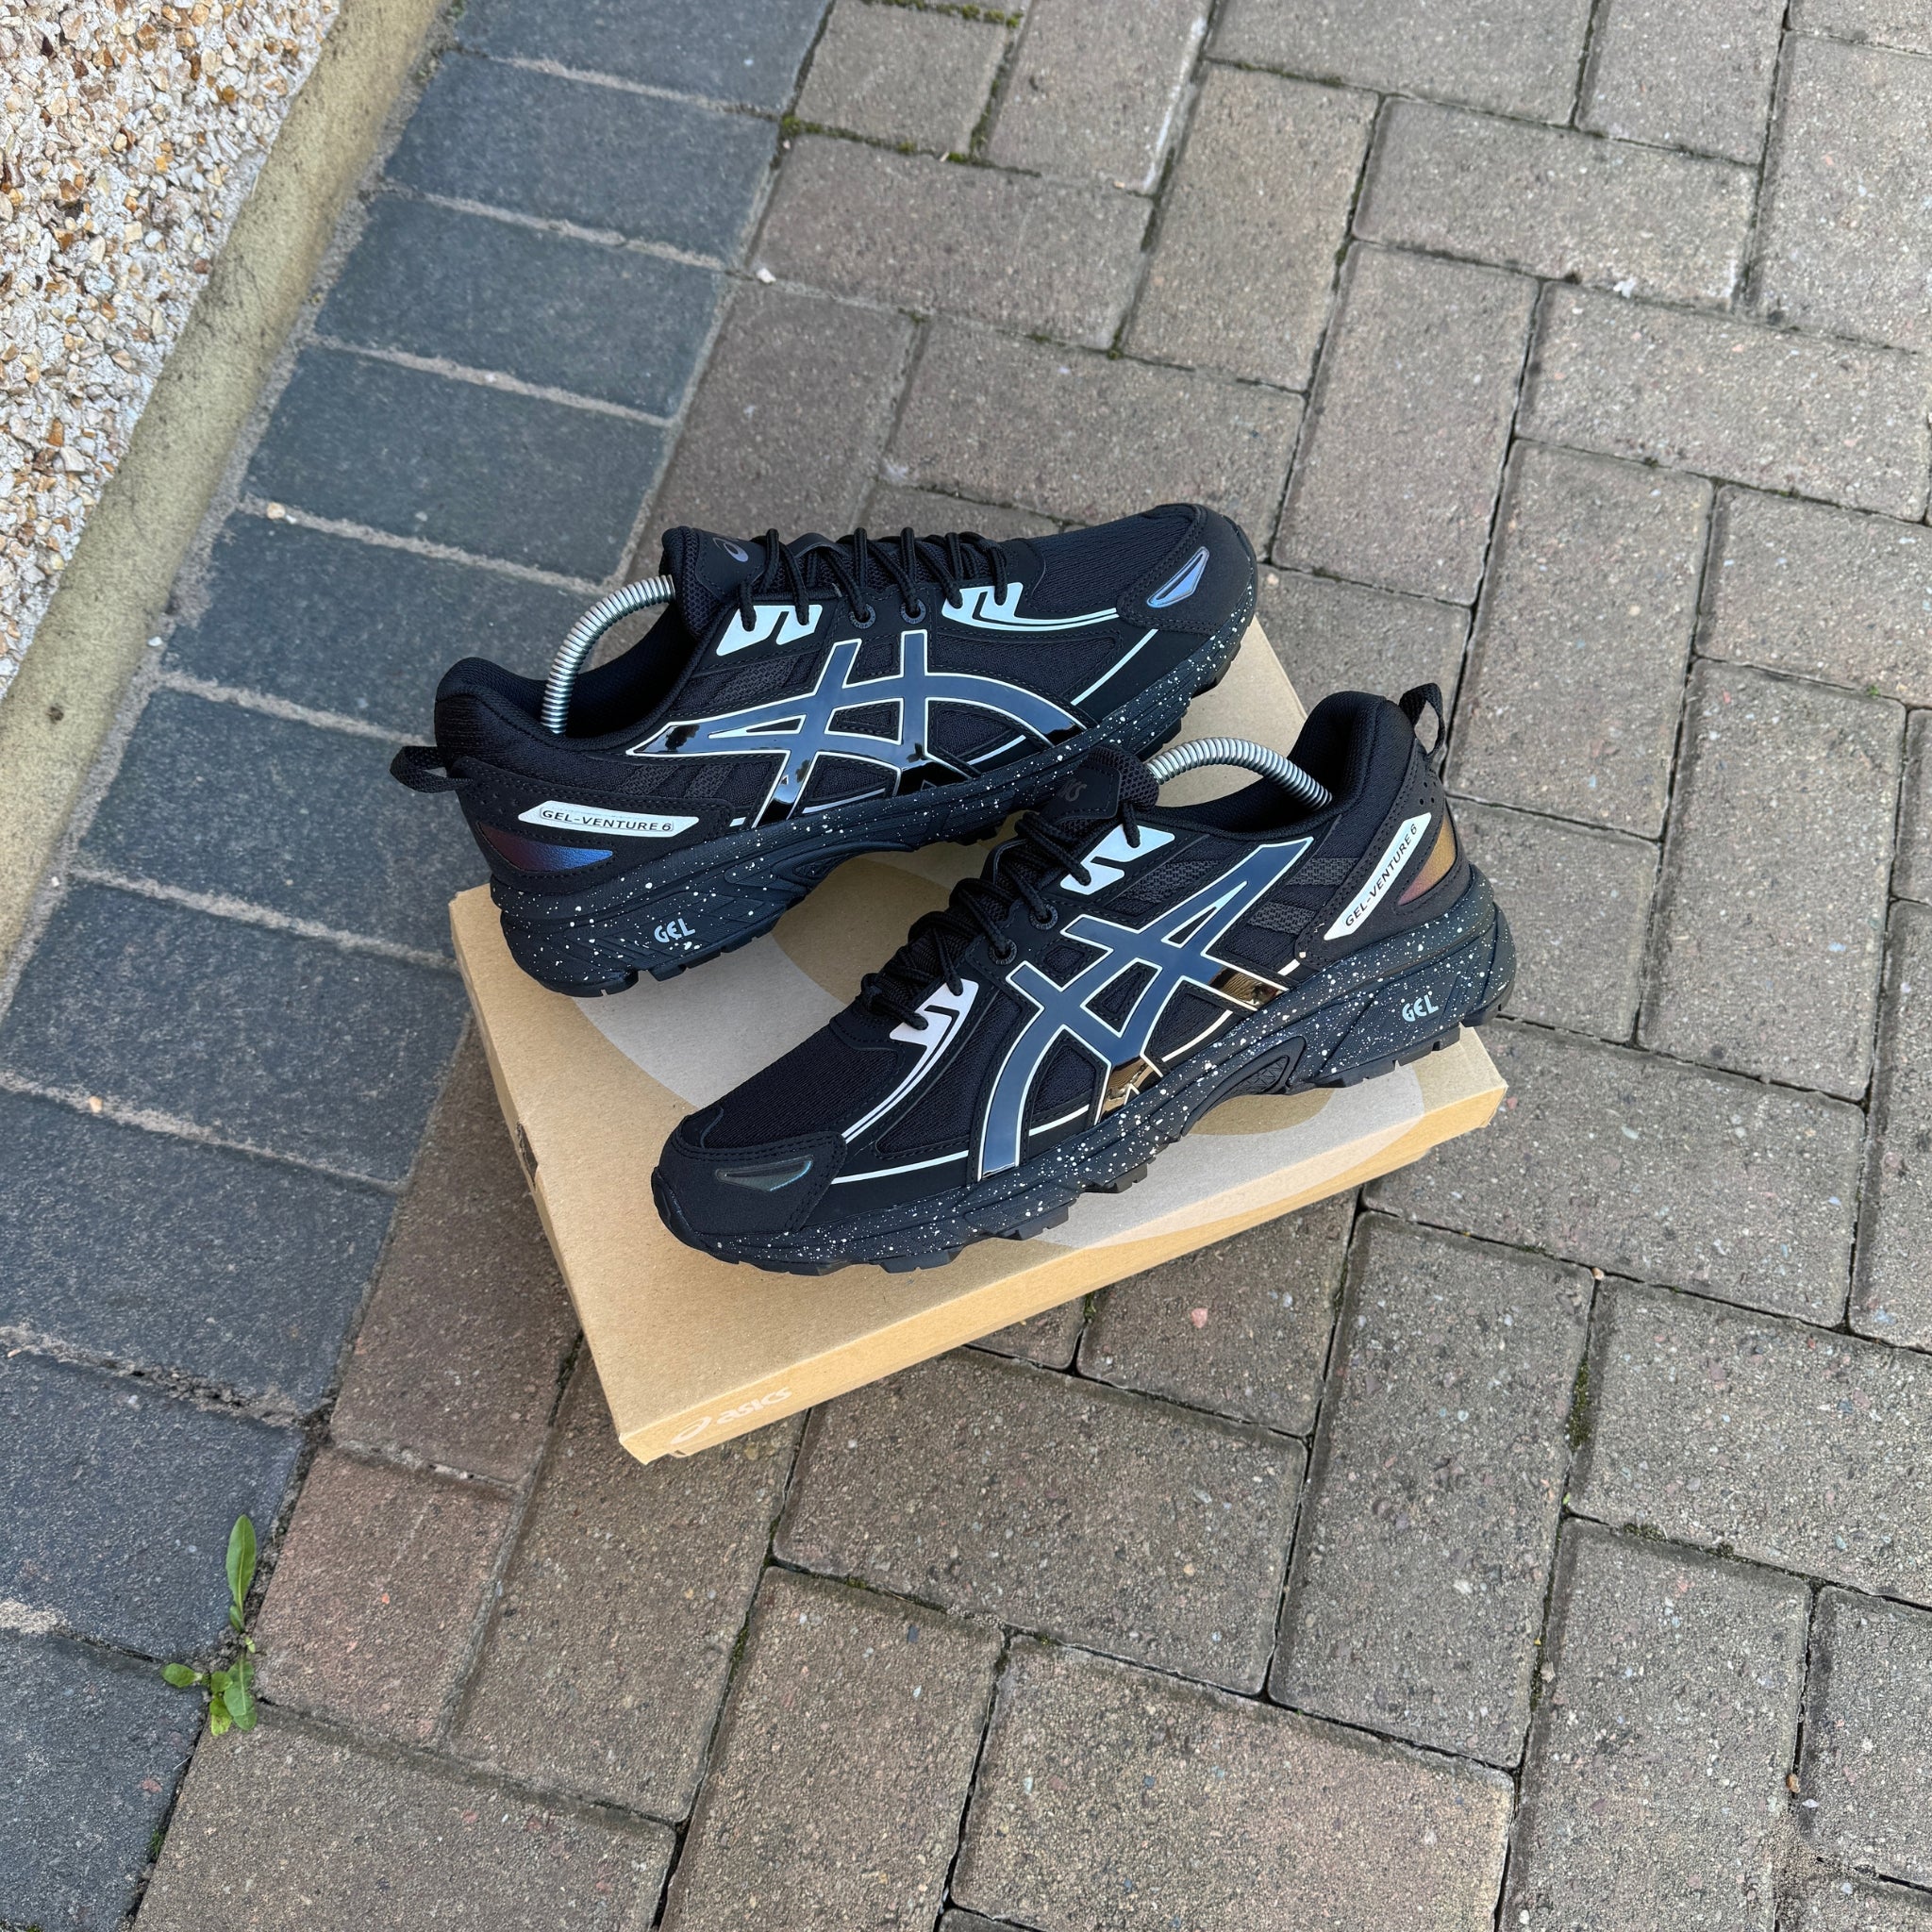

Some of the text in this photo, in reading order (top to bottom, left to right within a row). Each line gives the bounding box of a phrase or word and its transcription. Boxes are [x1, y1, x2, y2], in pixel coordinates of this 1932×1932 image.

[542, 809, 672, 831] GEL-VENTURE 6
[1345, 824, 1417, 926] GEL-VENTURE 6
[654, 918, 695, 943] GEL
[1402, 994, 1439, 1022] GEL
[717, 1387, 792, 1424] asics
